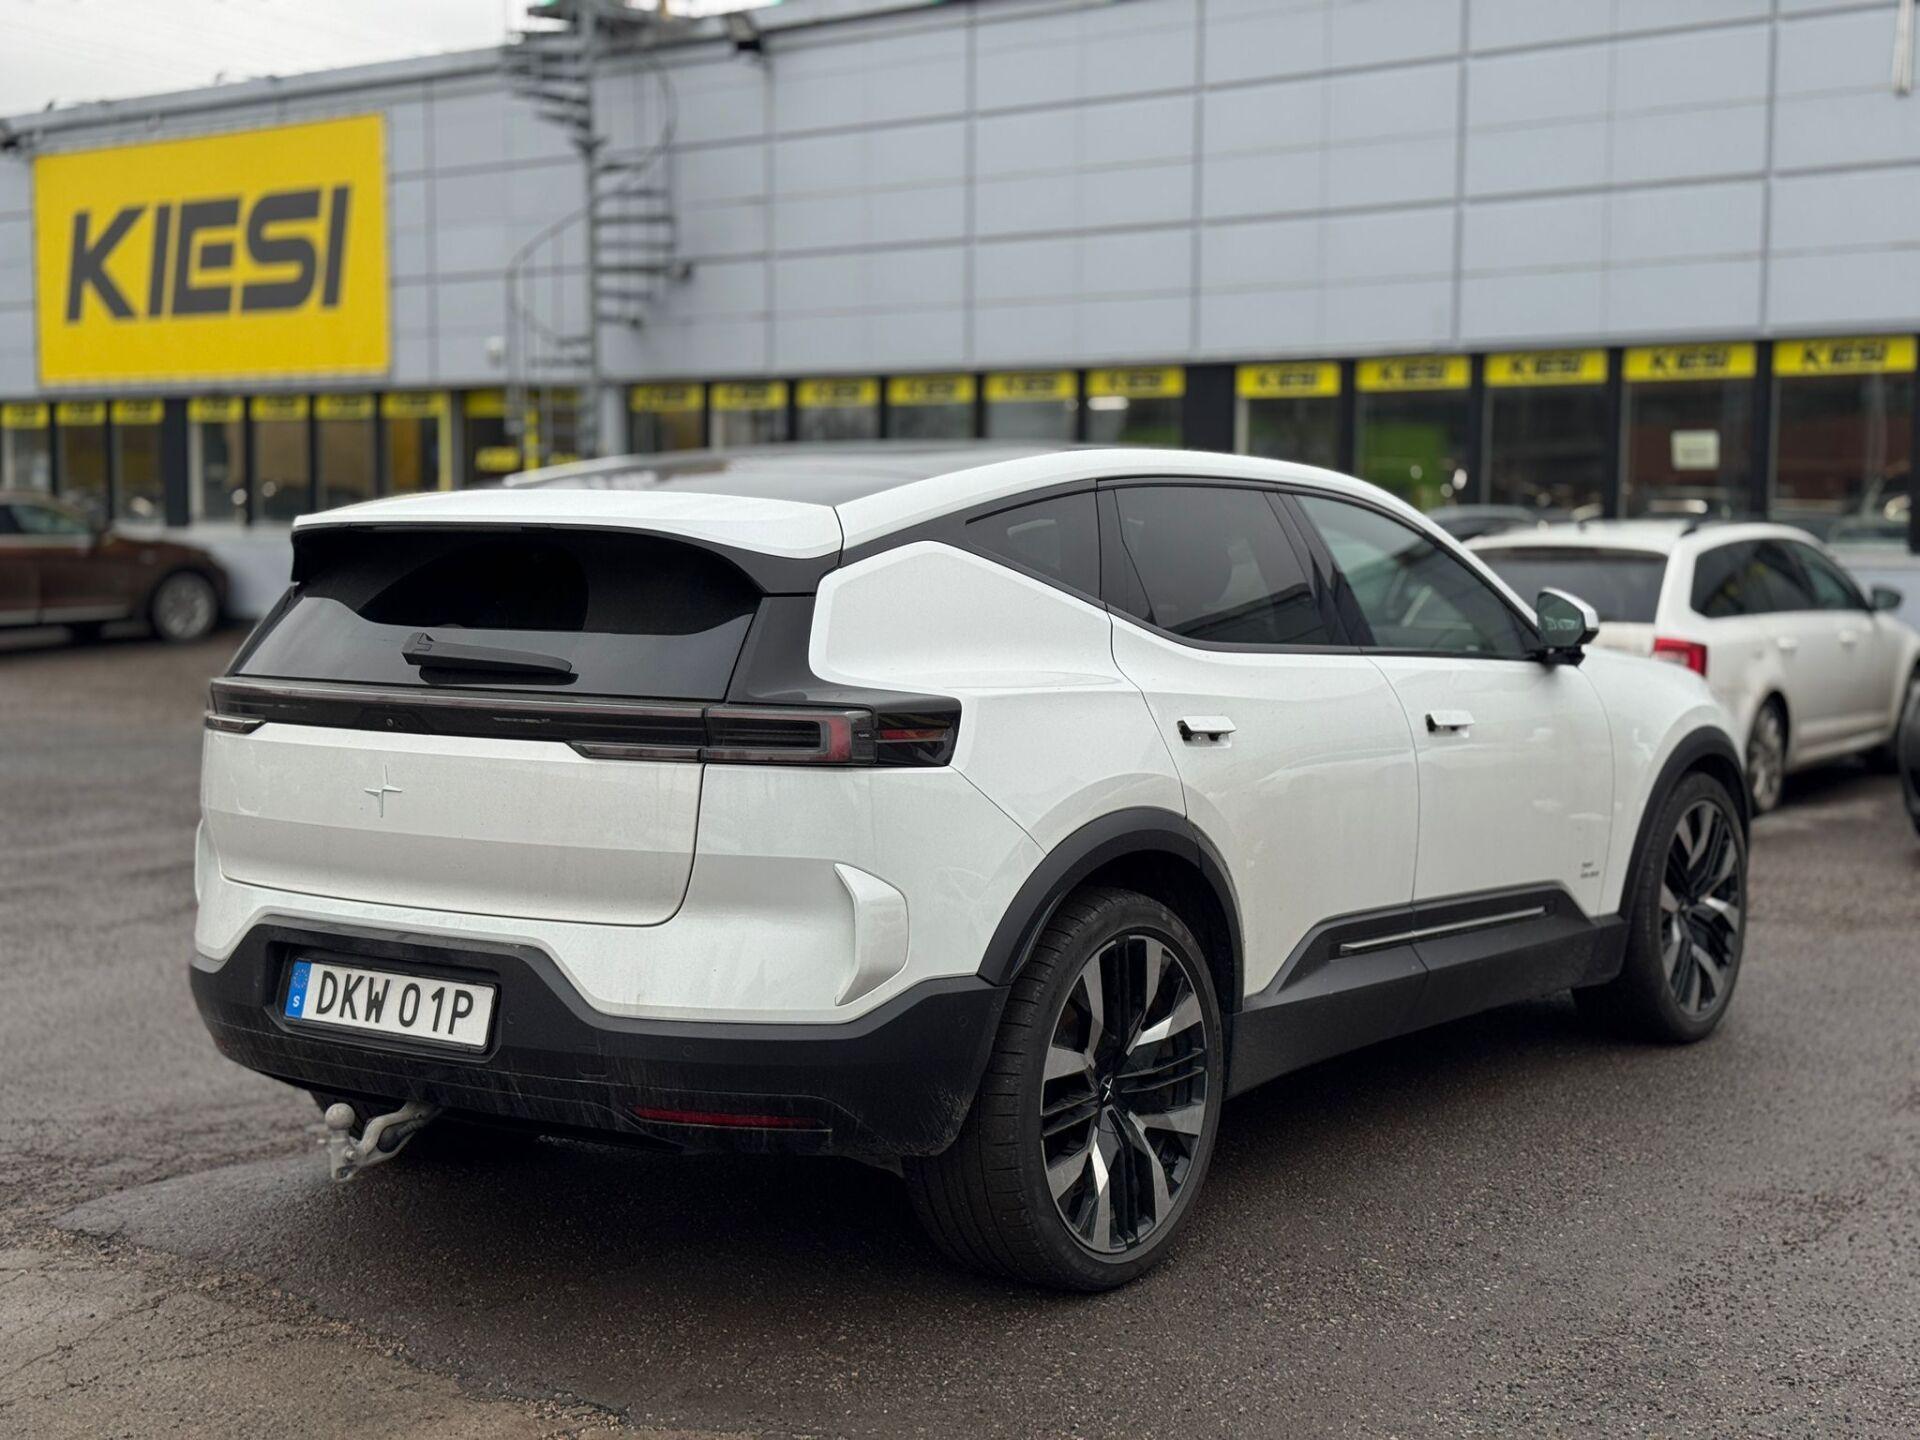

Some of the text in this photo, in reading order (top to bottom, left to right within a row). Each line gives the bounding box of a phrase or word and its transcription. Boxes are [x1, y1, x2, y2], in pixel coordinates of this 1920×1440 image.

[65, 184, 351, 324] KIESI
[292, 995, 301, 1008] S
[316, 970, 474, 1035] DKW 01P
